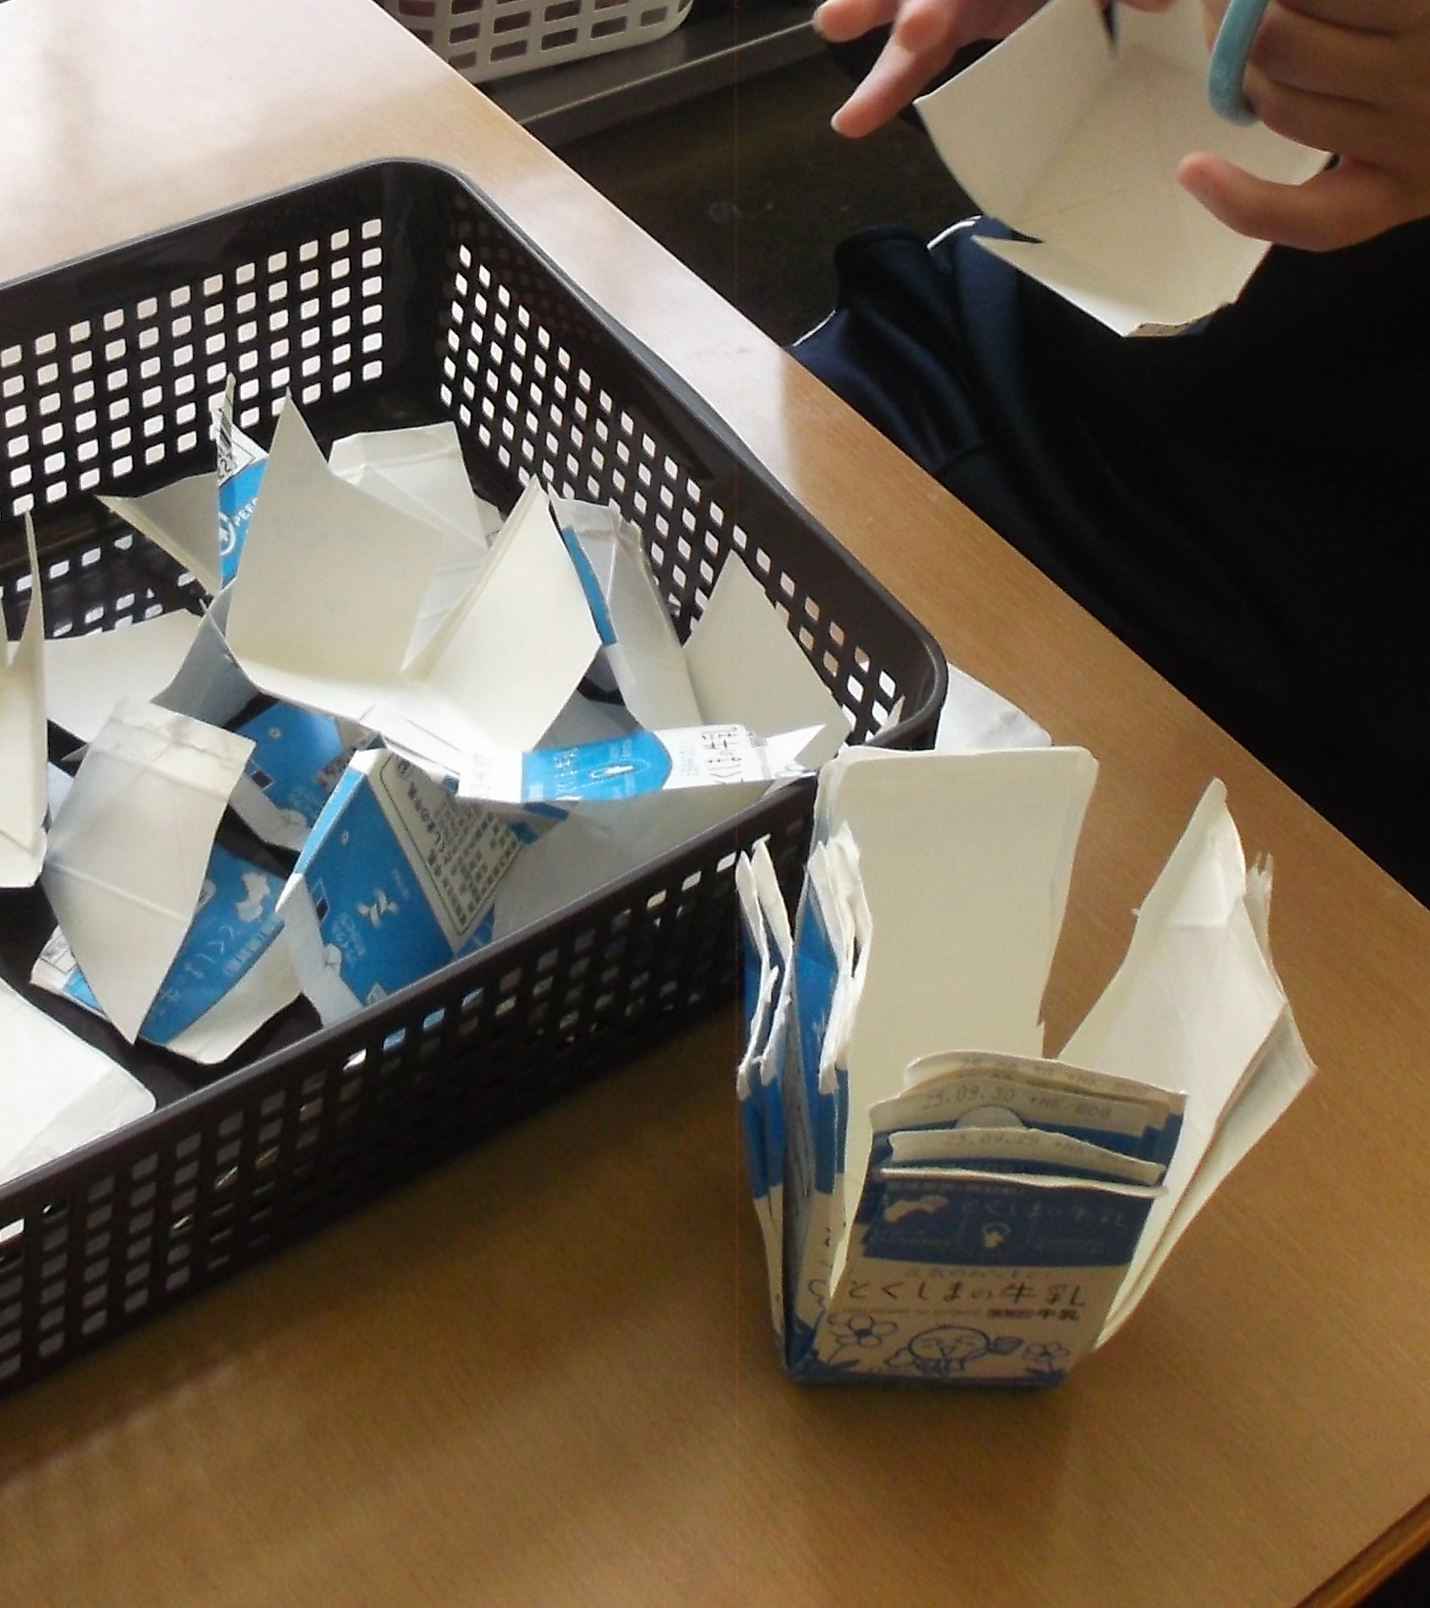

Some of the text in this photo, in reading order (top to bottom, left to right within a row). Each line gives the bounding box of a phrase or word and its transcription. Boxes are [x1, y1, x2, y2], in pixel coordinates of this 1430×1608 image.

[847, 1280, 1086, 1309] とくしまの牛乳
